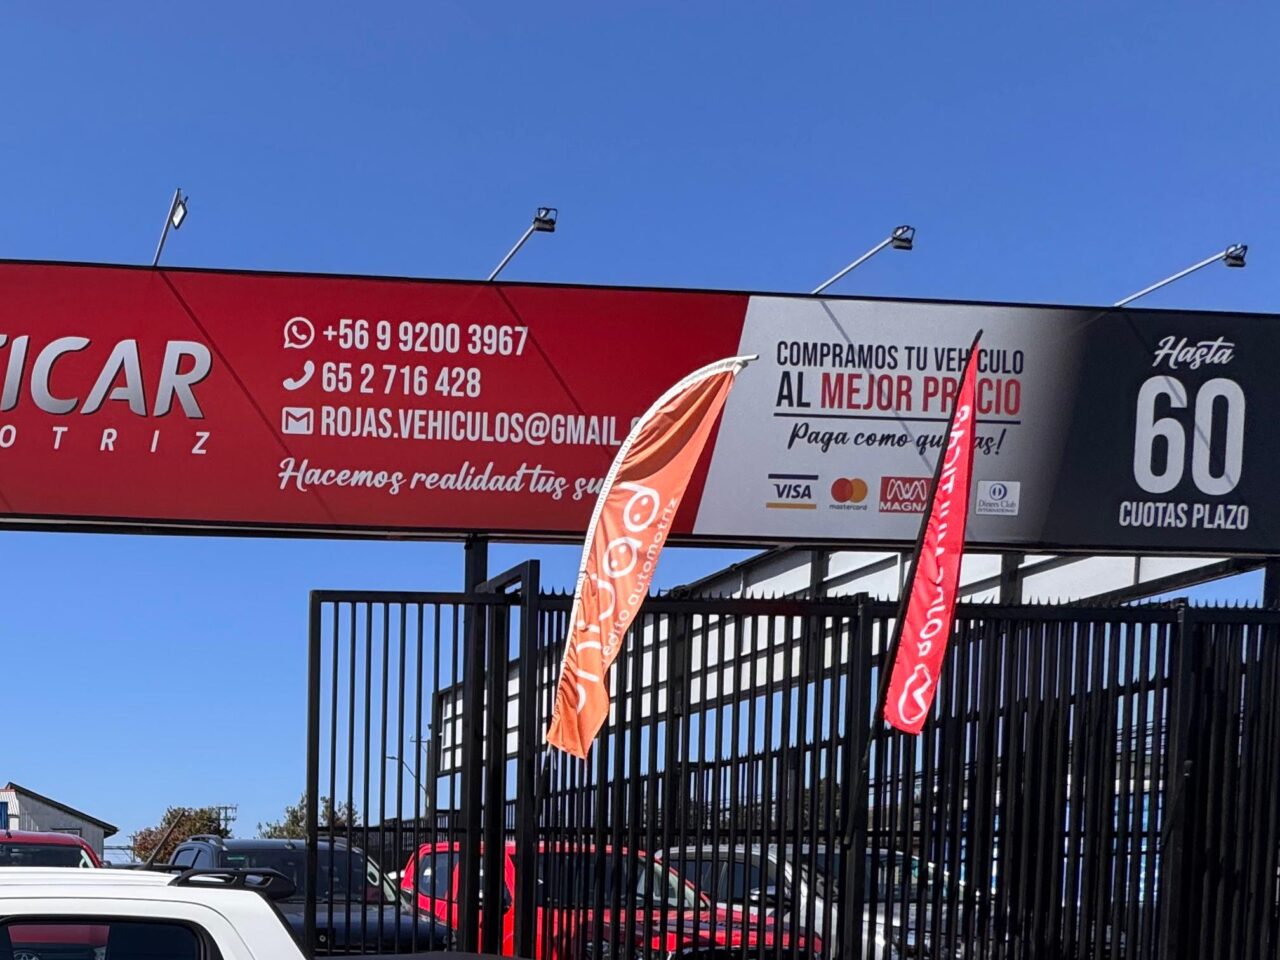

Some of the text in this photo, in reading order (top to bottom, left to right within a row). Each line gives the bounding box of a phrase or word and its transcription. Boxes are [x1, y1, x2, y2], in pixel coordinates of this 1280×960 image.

[323, 319, 528, 356] +56 9 9200 3967
[1152, 336, 1235, 370] Hasta
[776, 340, 1024, 375] COMPRAMOS TU VEHCULO
[322, 361, 481, 398] 65 2 716 428
[775, 371, 1021, 416] AL MEJOR PRCIO
[787, 422, 851, 453] Paga
[854, 431, 913, 448] como
[1133, 375, 1246, 496] 60
[279, 457, 407, 495] Hacemos
[410, 461, 526, 493] realidad
[521, 467, 569, 500] tus
[773, 483, 812, 500] VISA
[1119, 501, 1249, 530] CUOTAS PLAZO
